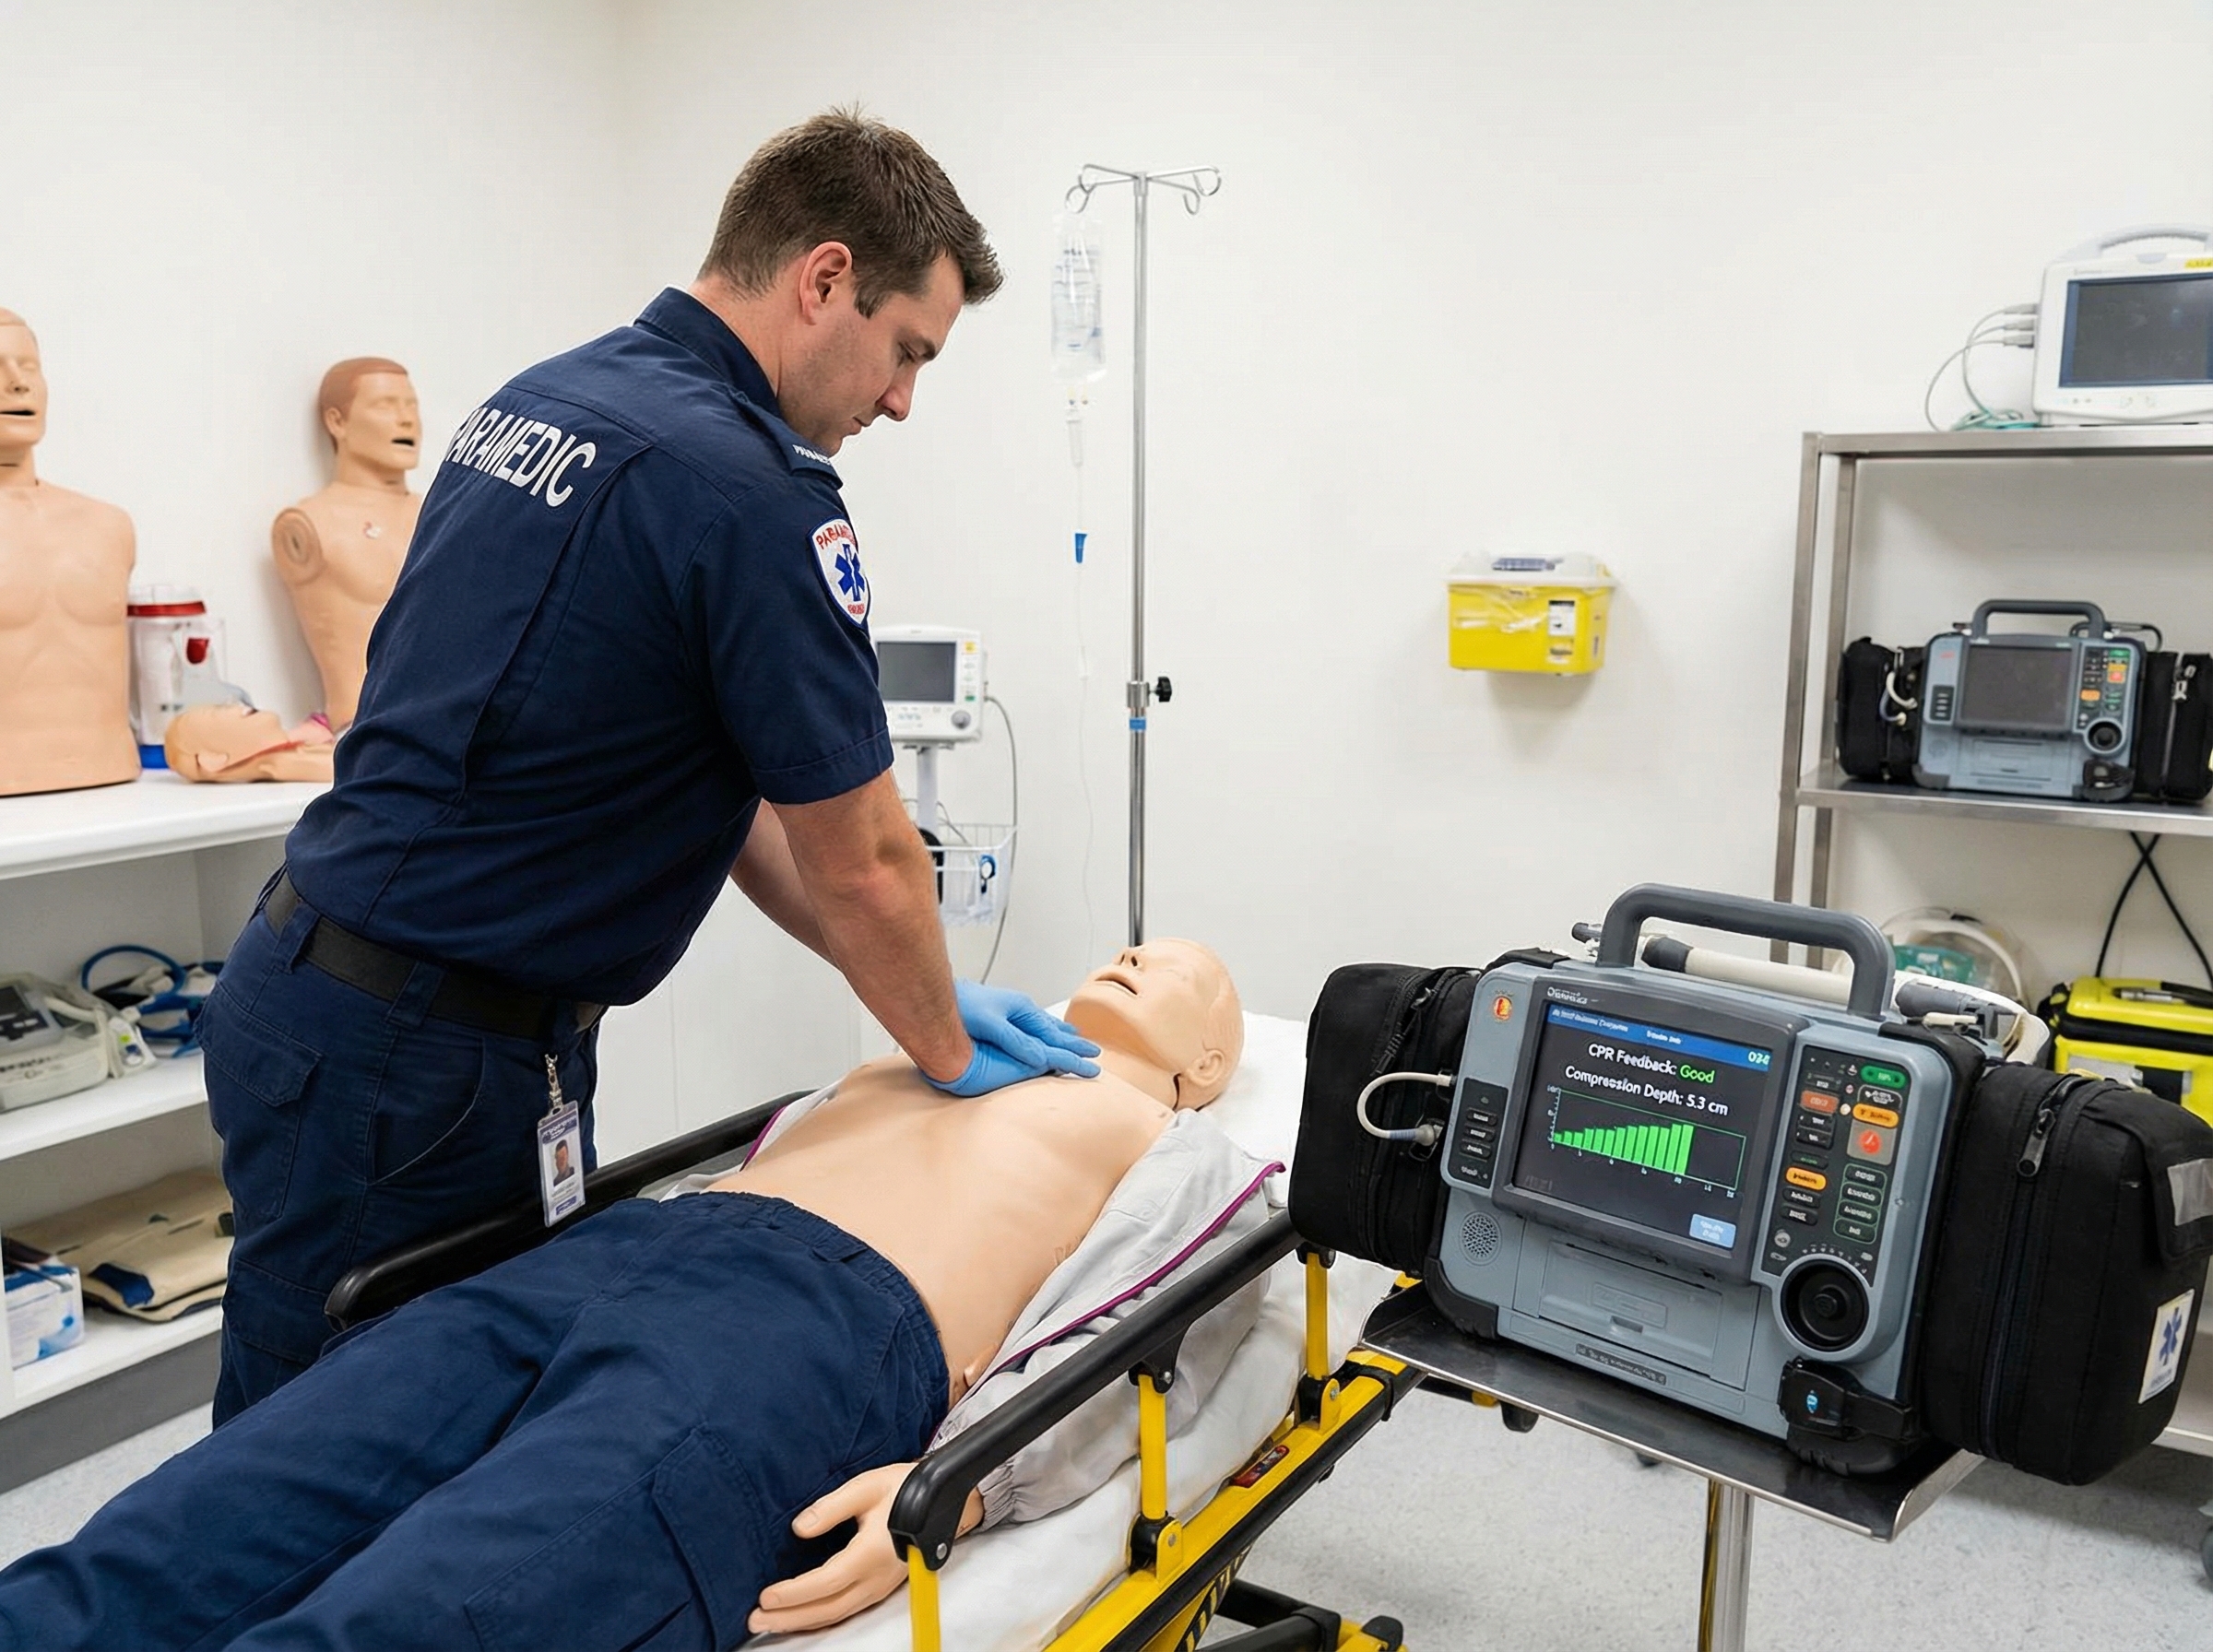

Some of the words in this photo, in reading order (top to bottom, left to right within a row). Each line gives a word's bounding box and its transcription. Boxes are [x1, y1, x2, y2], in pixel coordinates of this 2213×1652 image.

[1588, 1044, 1615, 1061] CPR
[1680, 1064, 1715, 1083] Good
[1643, 1083, 1684, 1104] Depth:
[1686, 1093, 1707, 1110] 5.3
[1708, 1102, 1729, 1116] cm
